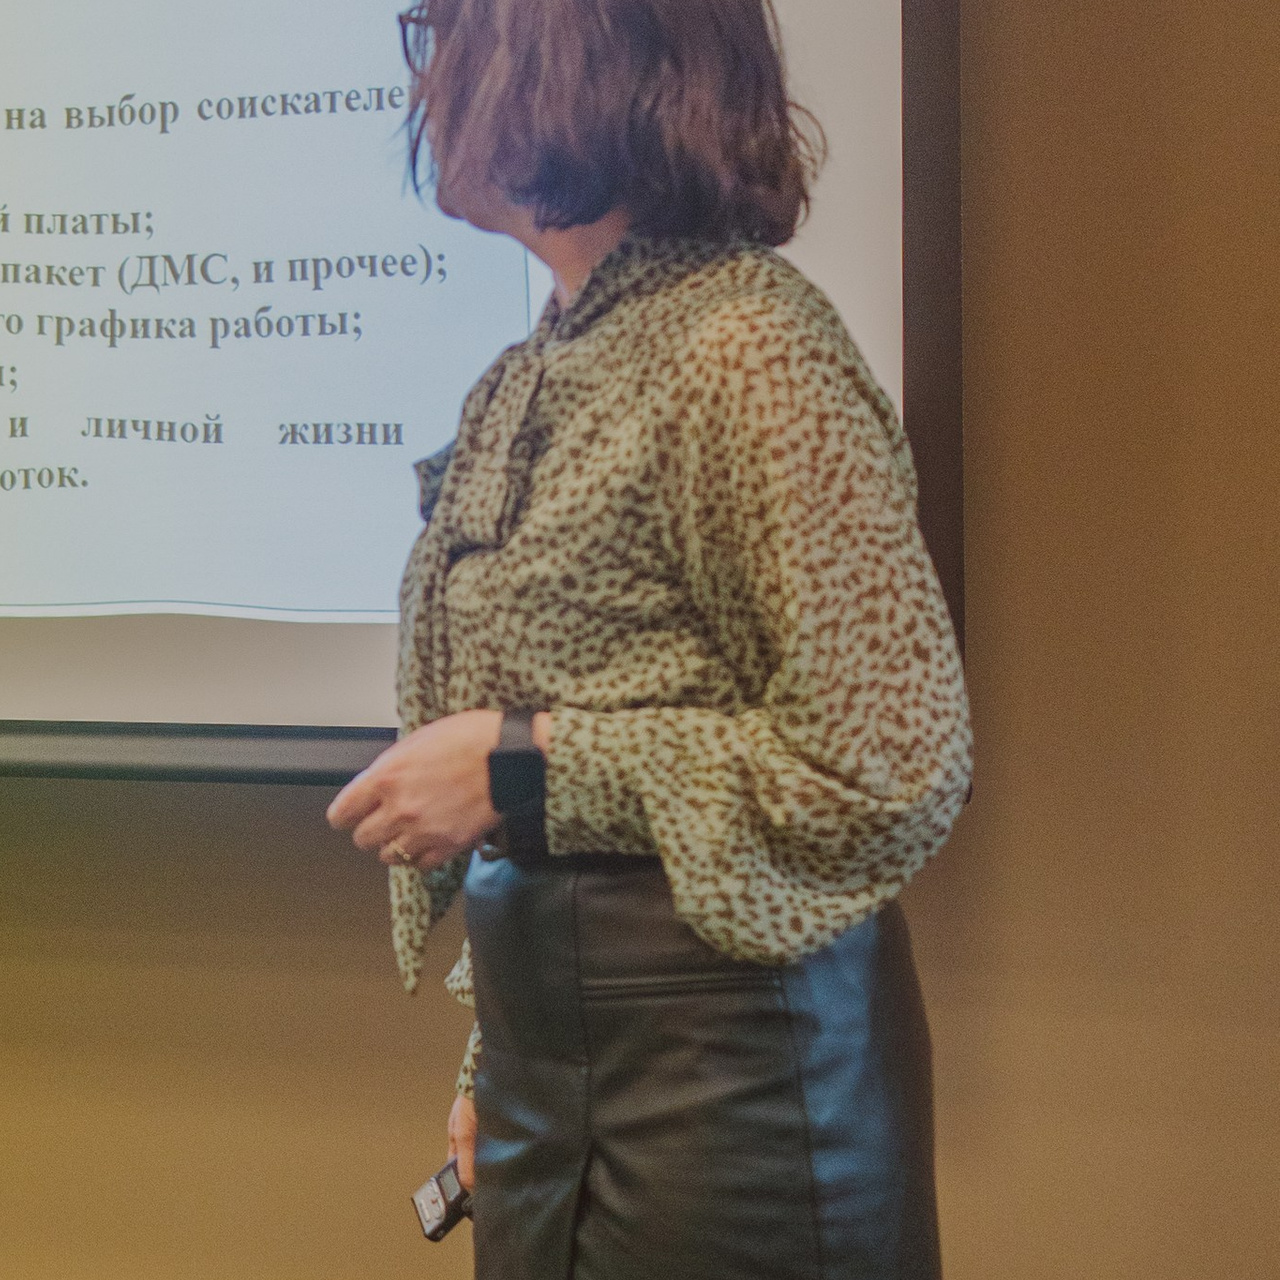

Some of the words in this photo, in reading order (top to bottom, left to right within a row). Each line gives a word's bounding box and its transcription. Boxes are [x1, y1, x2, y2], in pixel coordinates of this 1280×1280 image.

[4, 107, 48, 131] на
[64, 92, 180, 135] выбор
[196, 86, 410, 122] соискателе
[23, 210, 154, 239] платы;
[0, 262, 107, 288] пакет
[117, 252, 240, 295] (ДМС,
[251, 259, 275, 285] и
[287, 243, 448, 292] прочее);
[36, 308, 197, 349] графика
[209, 305, 363, 350] работы;
[8, 415, 29, 439] и
[80, 413, 224, 445] личной
[277, 421, 404, 446] жизни
